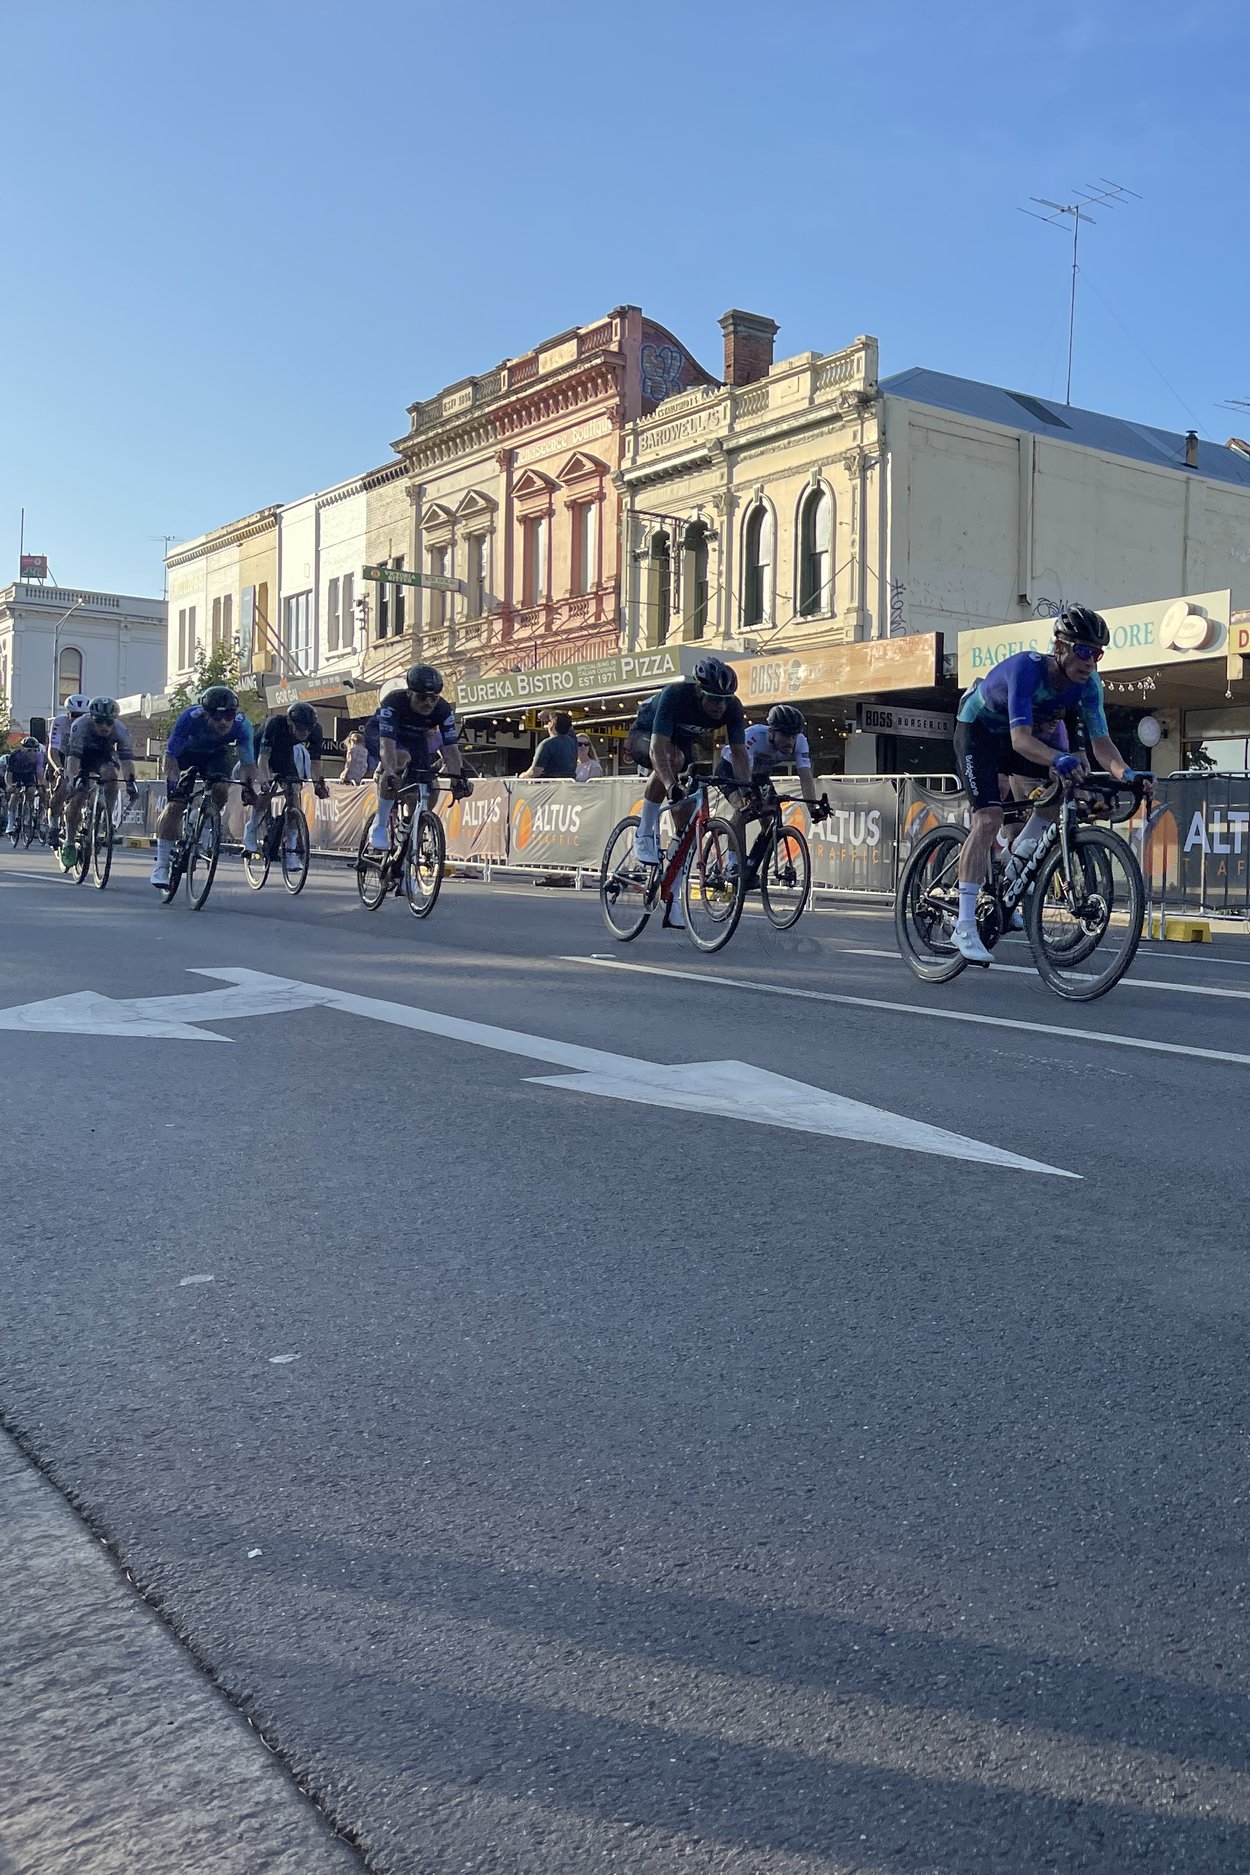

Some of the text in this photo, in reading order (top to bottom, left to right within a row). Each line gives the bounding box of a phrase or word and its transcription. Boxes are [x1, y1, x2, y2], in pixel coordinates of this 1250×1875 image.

[640, 404, 719, 451] BARDWELL'S
[1105, 621, 1155, 651] ORE
[578, 672, 617, 687] EST 1971
[621, 653, 676, 680] PIZZA
[750, 662, 782, 696] BOSS
[865, 709, 893, 728] BOSS
[314, 798, 339, 822] ALTUS
[461, 796, 502, 826] ALTUS
[532, 802, 583, 833] ALTUS
[531, 833, 580, 848] TRAFFIC
[807, 808, 881, 847] ALTUS
